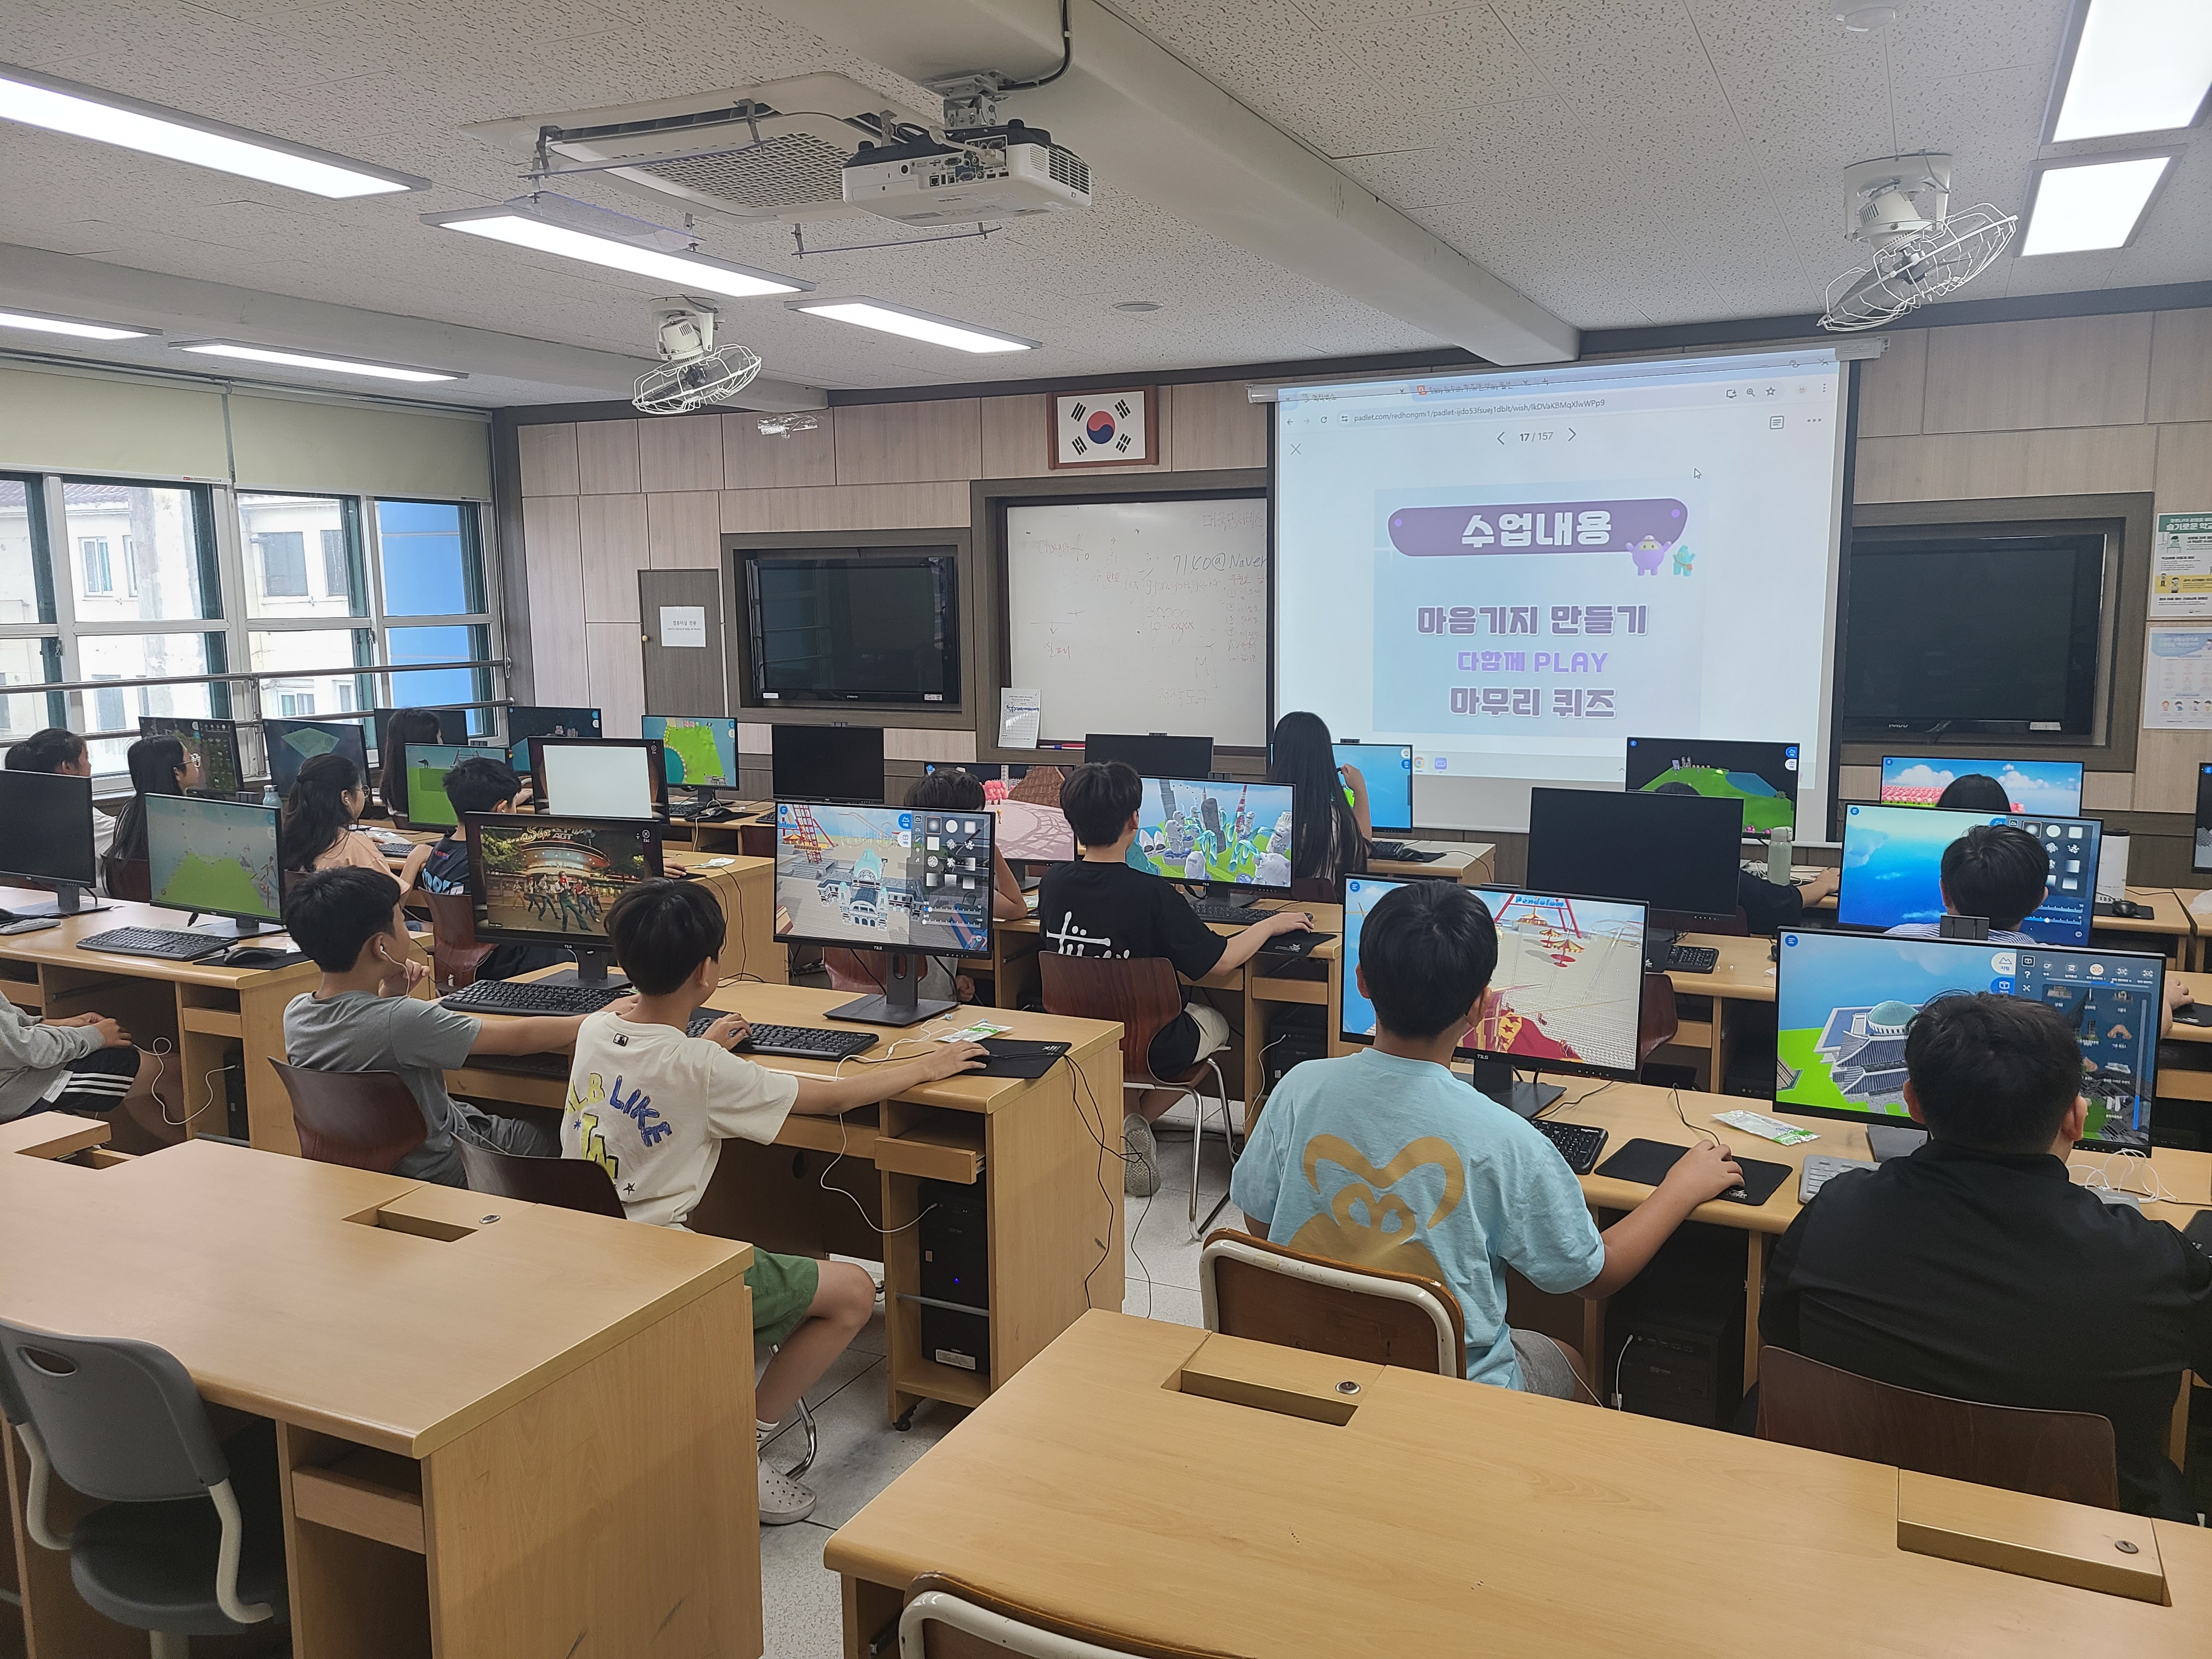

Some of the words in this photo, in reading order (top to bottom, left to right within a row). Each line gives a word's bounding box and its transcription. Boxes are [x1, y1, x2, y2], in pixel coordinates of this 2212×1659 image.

[1519, 433, 1530, 442] 17
[1537, 431, 1554, 441] 157
[1462, 510, 1612, 548] 수업내용
[1417, 605, 1540, 636] 마음기지
[1550, 605, 1648, 636] 만들기
[1457, 650, 1526, 673] 다함께
[1533, 651, 1609, 674] PLAY
[1158, 686, 1211, 713] 저작도구
[1449, 686, 1542, 718] 마무리
[1551, 688, 1617, 718] 퀴즈
[609, 1074, 673, 1147] LIKE
